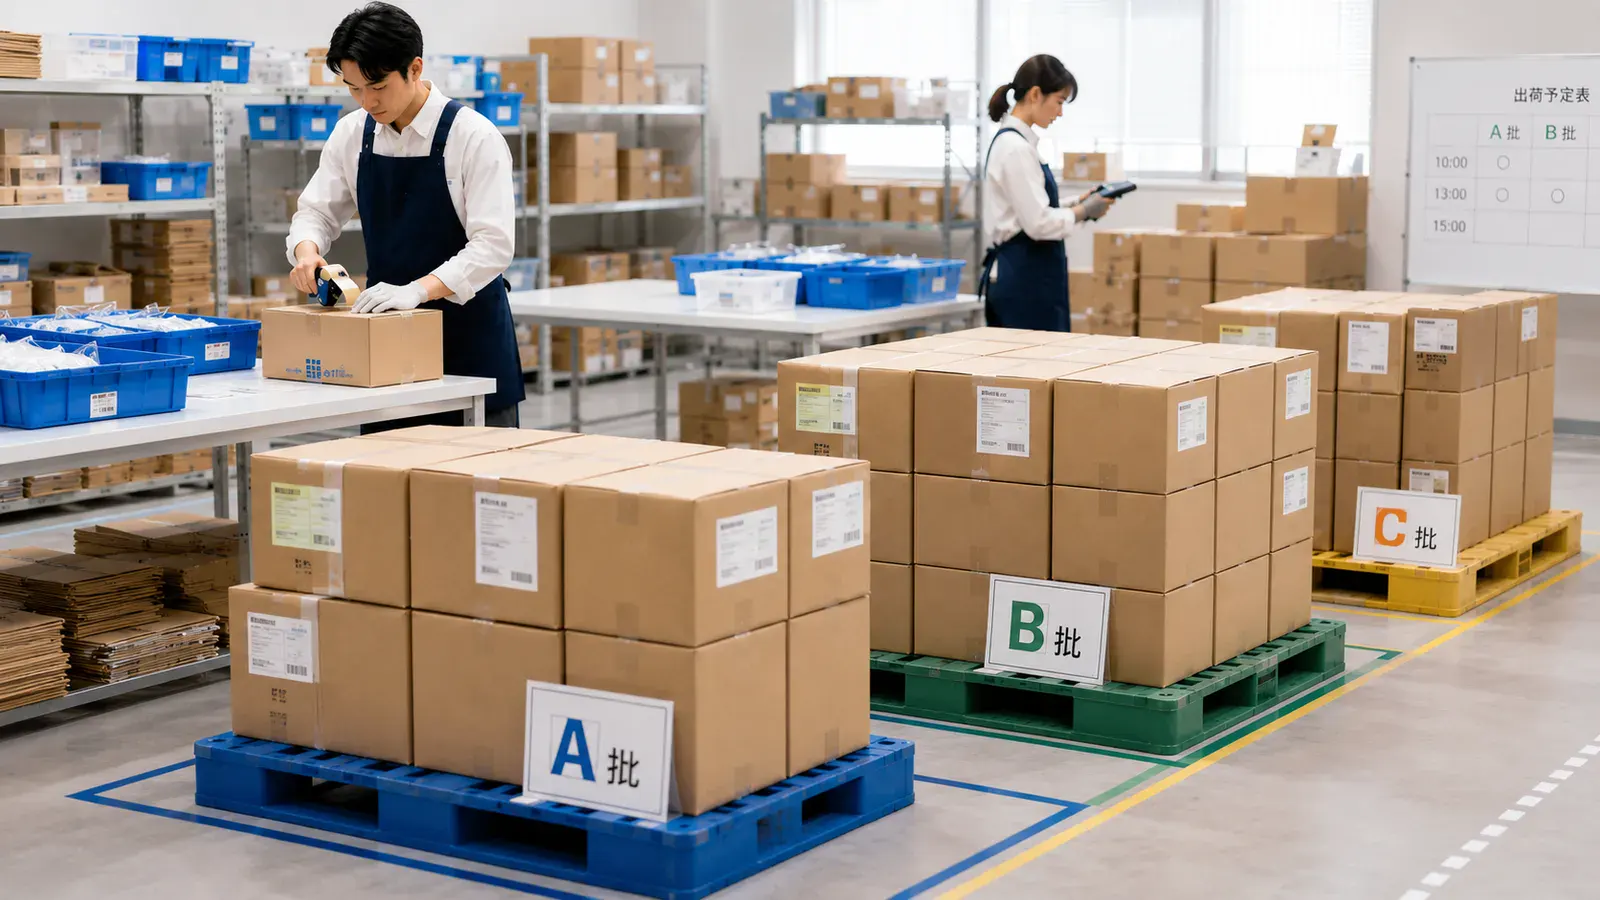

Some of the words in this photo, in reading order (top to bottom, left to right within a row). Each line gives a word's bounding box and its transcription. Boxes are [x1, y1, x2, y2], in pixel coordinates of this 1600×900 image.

[1514, 87, 1590, 103] 出荷予定表
[1490, 124, 1502, 140] A
[1507, 125, 1520, 141] 批
[1546, 124, 1557, 140] B
[1562, 125, 1576, 141] 批
[1435, 156, 1468, 169] 10:00
[1435, 187, 1467, 200] 13:00
[1433, 219, 1466, 233] 15:00
[1375, 507, 1407, 547] C
[1415, 526, 1437, 550] 批
[1009, 600, 1045, 653] B
[1054, 626, 1081, 658] 批
[550, 717, 596, 782] A
[607, 747, 639, 788] 批
